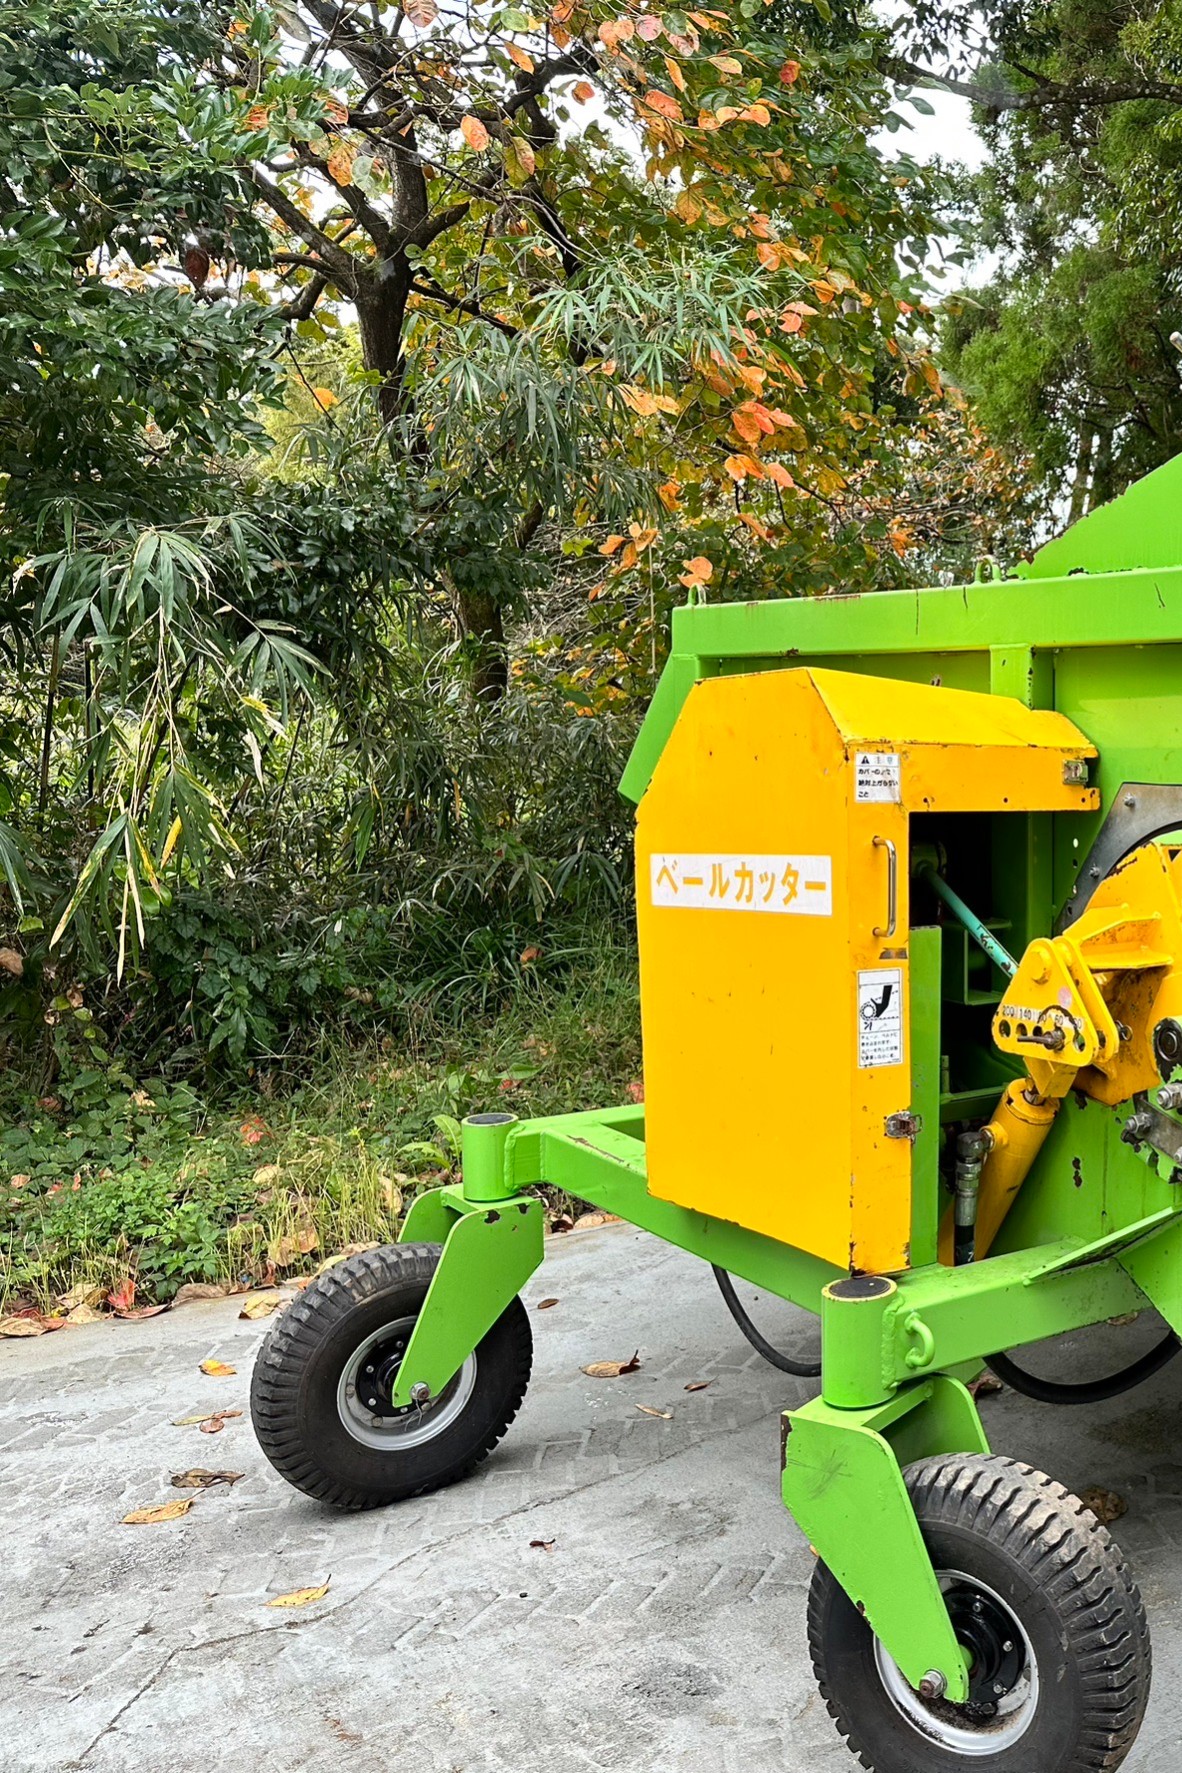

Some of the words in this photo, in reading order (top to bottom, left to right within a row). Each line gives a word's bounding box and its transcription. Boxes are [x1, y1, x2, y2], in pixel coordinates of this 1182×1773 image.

[656, 859, 827, 906] ベールカッター
[1019, 1008, 1032, 1021] 140
